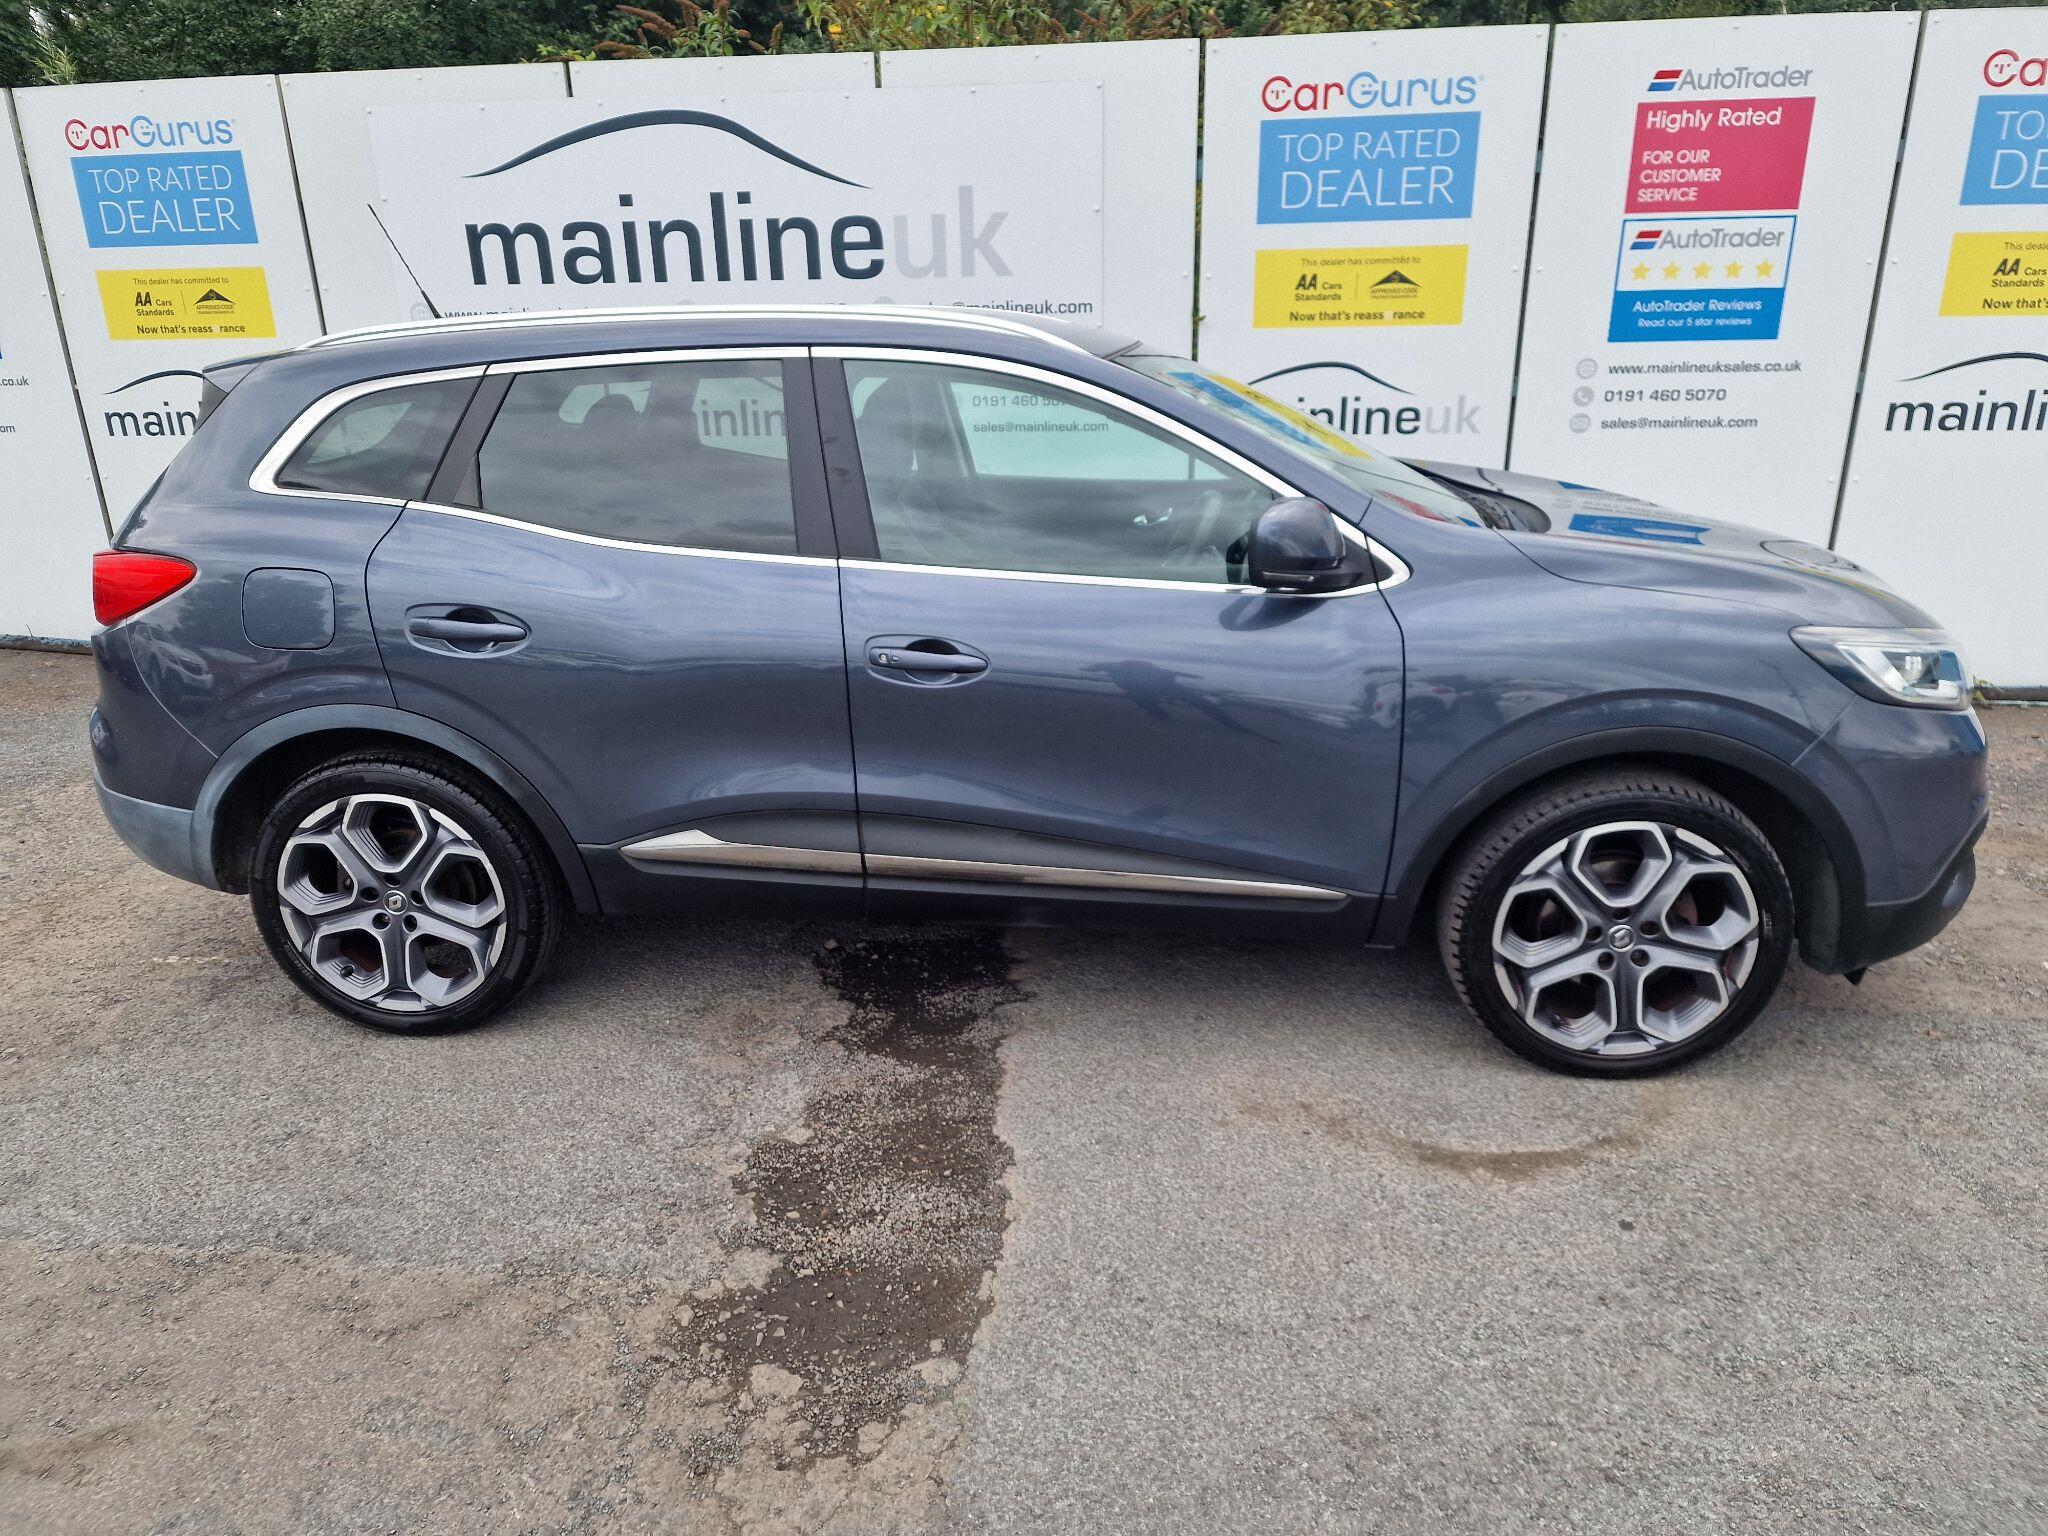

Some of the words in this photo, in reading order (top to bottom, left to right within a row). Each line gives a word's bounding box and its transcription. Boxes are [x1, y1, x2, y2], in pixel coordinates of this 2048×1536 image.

[1678, 65, 1813, 91] AutoTrader
[1261, 71, 1477, 112] CarGurus
[1646, 109, 1713, 133] Highly
[1717, 106, 1782, 127] Rated
[1996, 110, 2048, 140] TO
[65, 115, 233, 151] CarGurus
[1278, 132, 1344, 162] TOP
[1353, 128, 1461, 160] RATED
[1642, 150, 1674, 164] FOR
[1676, 149, 1710, 164] OUR
[88, 168, 139, 194] TOP
[147, 165, 232, 192] RATED
[1639, 168, 1721, 183] CUSTOMER
[1281, 165, 1454, 209] DEALER
[1637, 187, 1698, 202] SERVICE
[98, 197, 241, 234] DEALER
[1658, 228, 1785, 249] AutoTrader
[2005, 241, 2023, 250] This
[1301, 258, 1317, 266] This
[1319, 257, 1346, 267] dealer
[1347, 257, 1363, 266] has
[1364, 255, 1410, 265] committed
[1412, 256, 1421, 264] to
[1993, 258, 2021, 276] AA
[2024, 267, 2047, 276] Cars
[184, 276, 220, 284] committed
[221, 276, 229, 284] to
[1295, 273, 1318, 290] AA
[1322, 281, 1343, 290] Cars
[1991, 278, 2045, 288] Standards
[135, 291, 152, 306] AA
[155, 299, 173, 307] Cars
[1295, 292, 1342, 301] Standards
[1982, 298, 2013, 309] Now
[136, 308, 175, 317] Standards
[1632, 300, 1705, 312] AutoTrader
[1708, 298, 1762, 311] Reviews
[1289, 311, 1316, 321] Now
[1319, 310, 1351, 321] that's
[1353, 309, 1426, 320] reassrance
[1637, 317, 1665, 327] Read
[1667, 318, 1684, 327] our
[1686, 317, 1693, 327] 5
[1695, 317, 1712, 327] star
[1715, 317, 1753, 326] reviews
[137, 325, 158, 334] Now
[160, 324, 187, 334] that's
[188, 324, 246, 333] reassrance
[1608, 359, 1801, 374] www.mainlineuksales.co.uk
[972, 395, 1007, 407] 0191
[1011, 395, 1039, 406] 460
[1604, 389, 1643, 402] 0191
[1649, 388, 1681, 401] 460
[1685, 388, 1727, 401] 5070
[973, 421, 1109, 433] sales@mainlineuk.com
[1600, 415, 1758, 429] sales@mainlineuk.com
